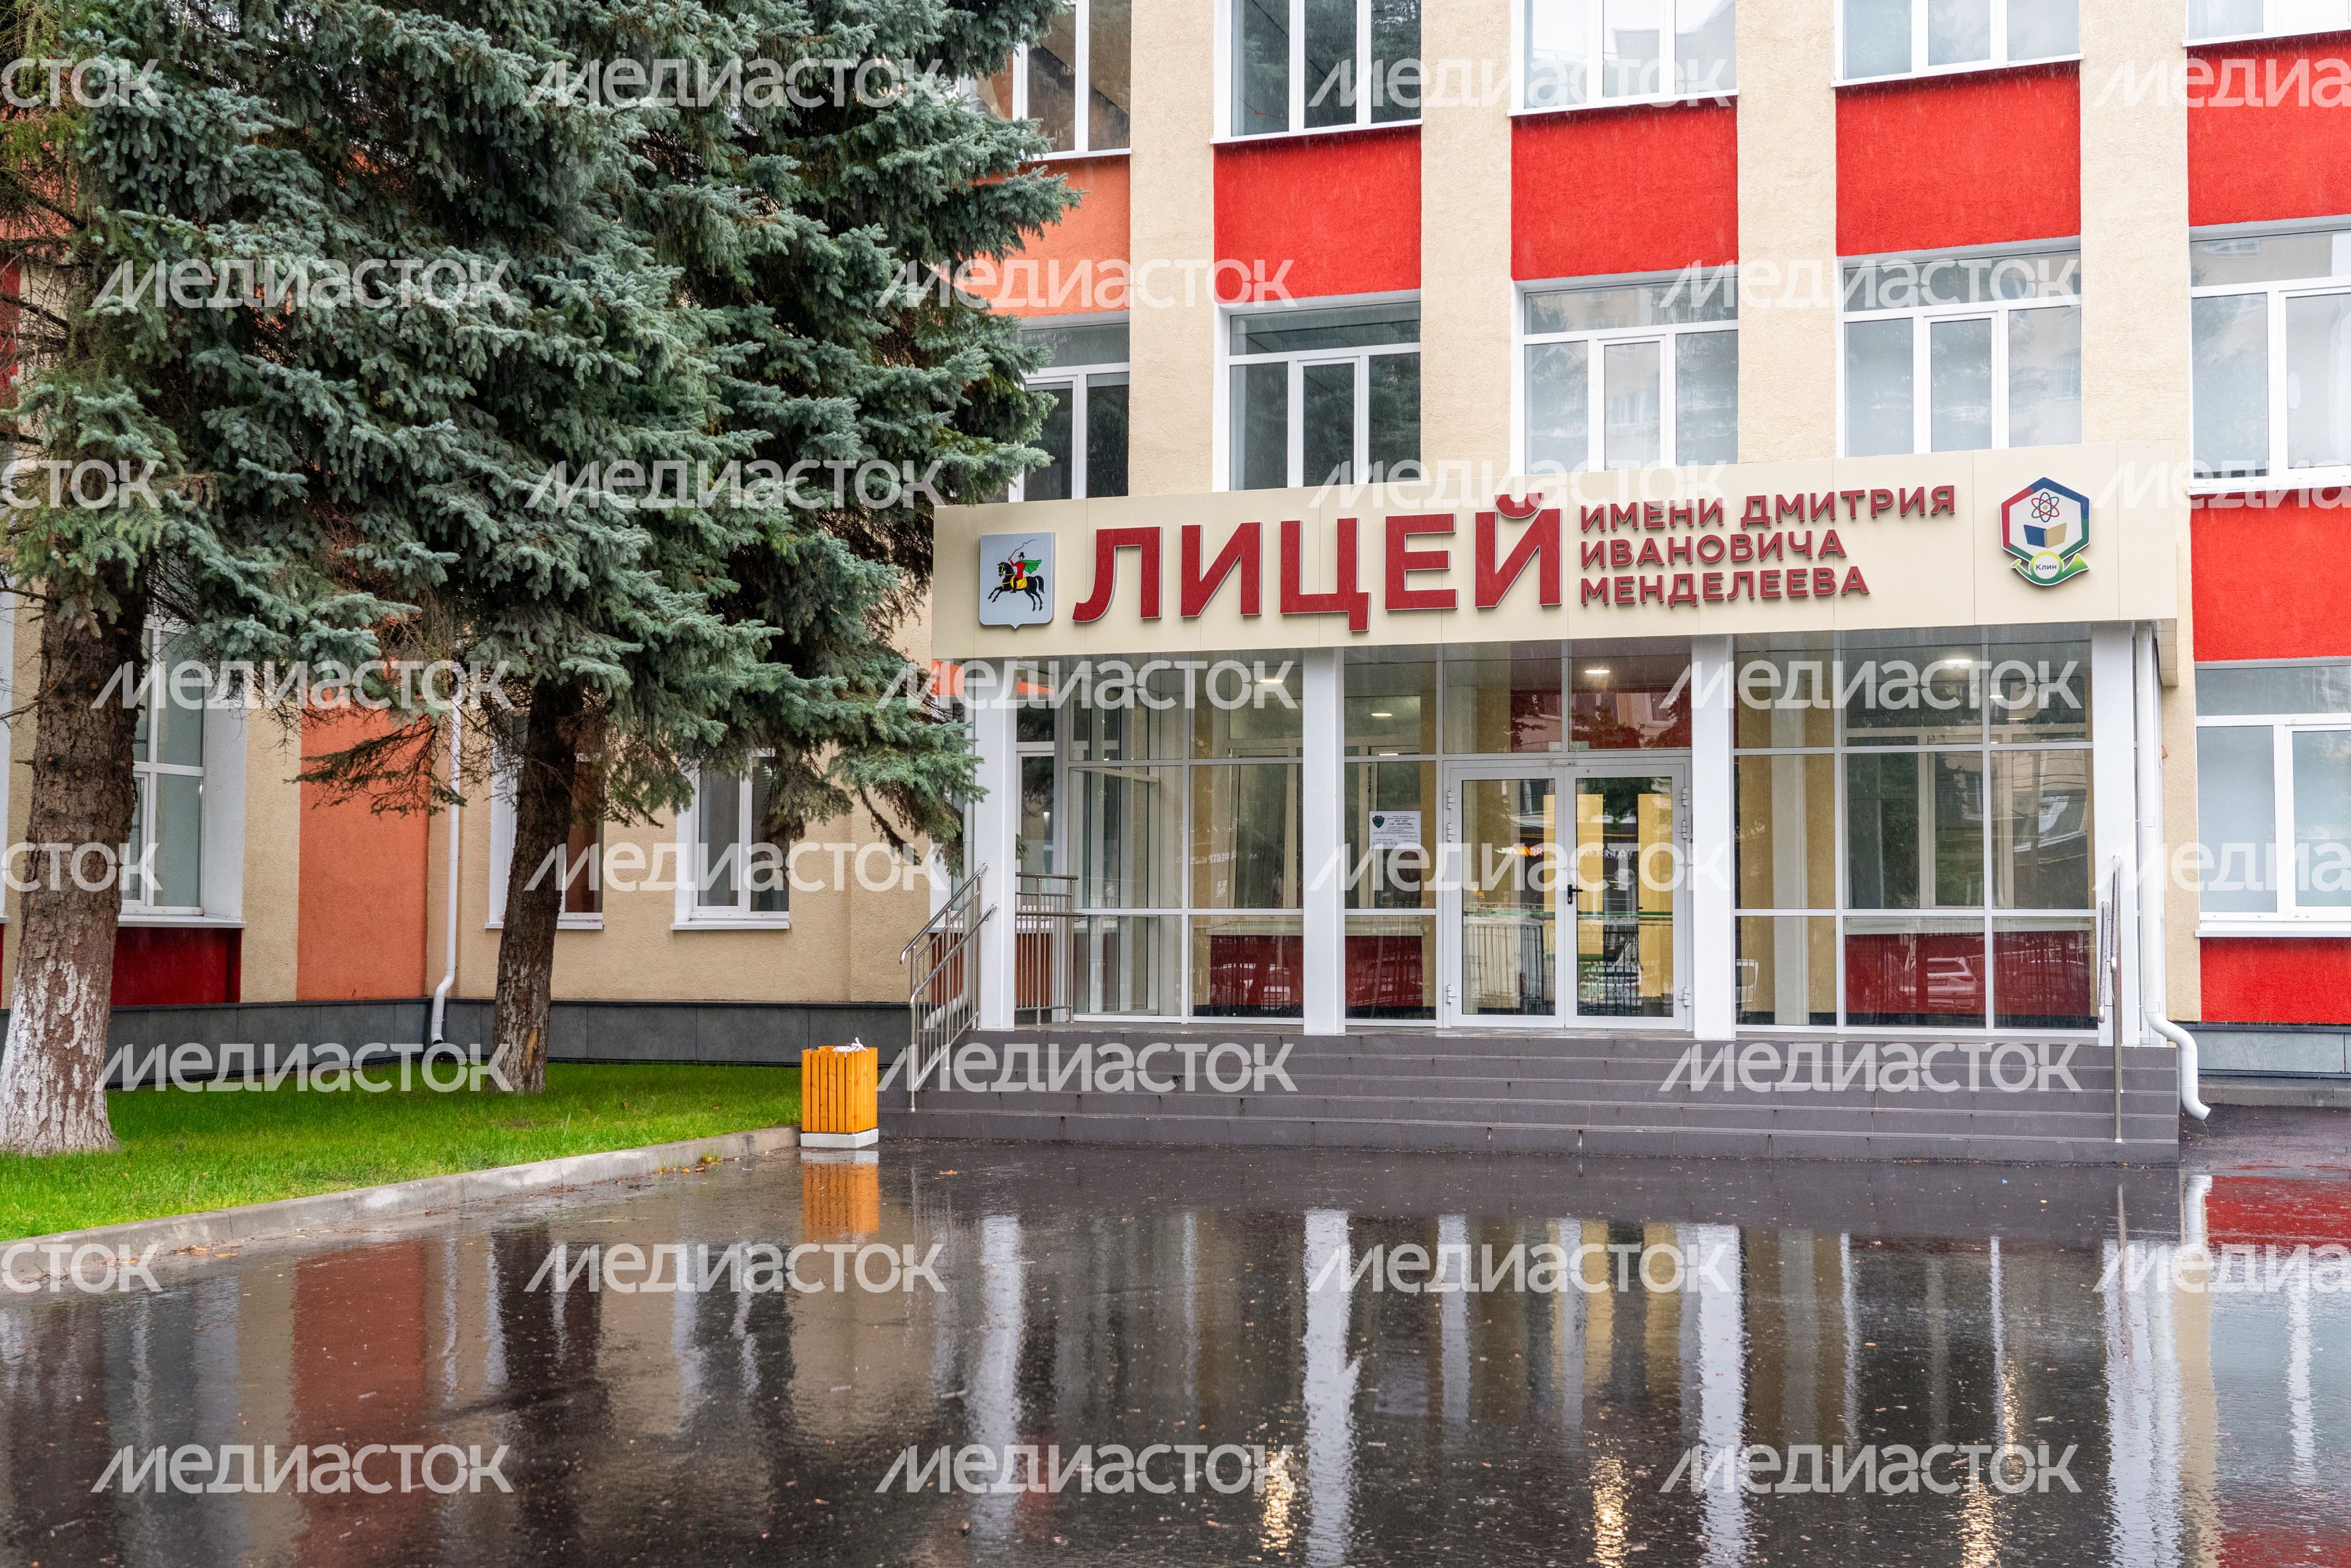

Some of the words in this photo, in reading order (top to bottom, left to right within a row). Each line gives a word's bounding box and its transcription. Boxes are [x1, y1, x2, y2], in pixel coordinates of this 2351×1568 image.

[1581, 499, 1724, 531] ИМЕНИ
[1740, 486, 1956, 528] ДМИТРИЯ
[1072, 492, 1562, 632] ЛИЦЕЙ
[1581, 530, 1847, 568] ИВАНОВИЧА
[1581, 566, 1870, 606] МЕНДЕЛЕЕВА
